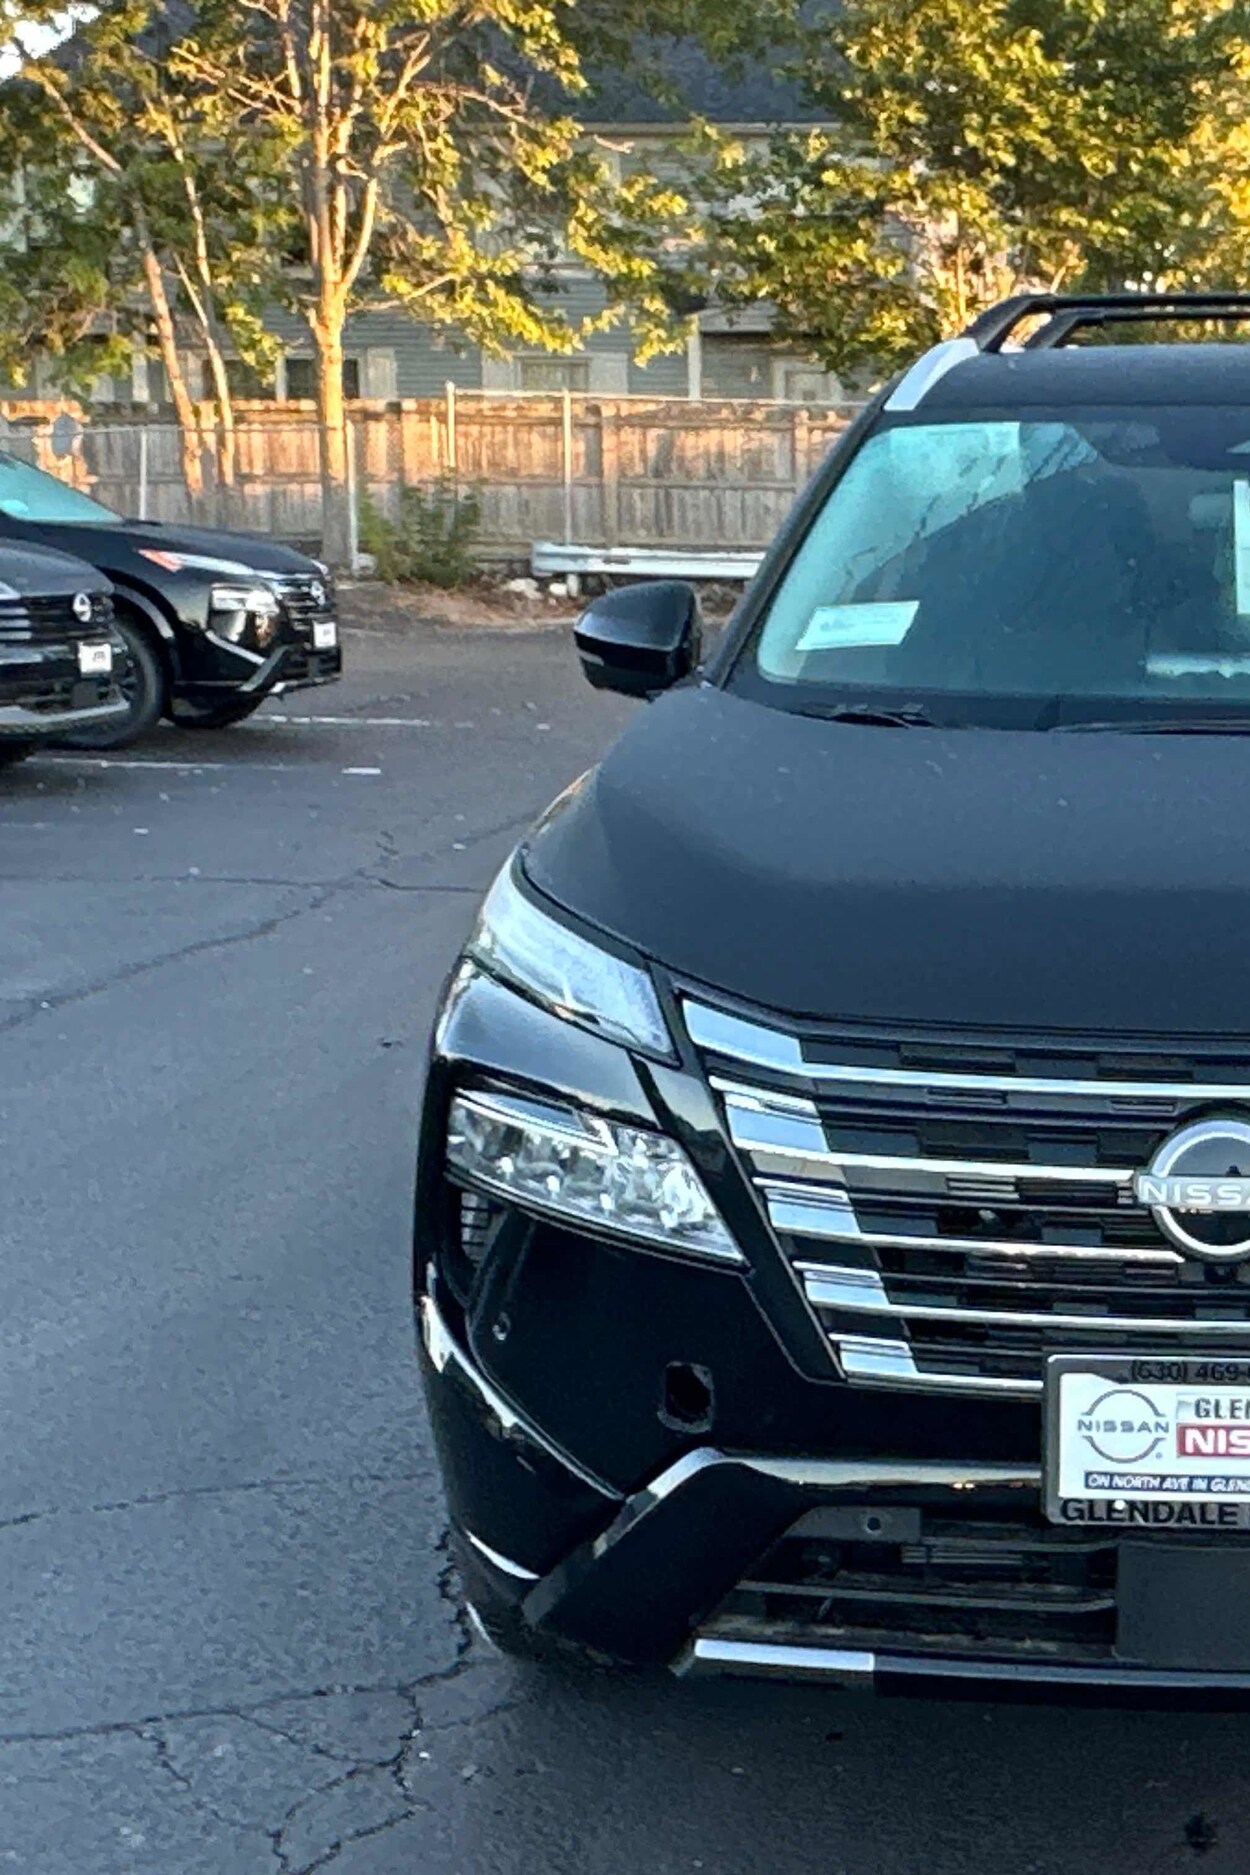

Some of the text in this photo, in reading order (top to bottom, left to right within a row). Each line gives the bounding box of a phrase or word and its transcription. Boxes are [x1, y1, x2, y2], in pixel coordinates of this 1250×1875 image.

[1131, 1360, 1188, 1382] (630)
[1077, 1419, 1169, 1434] NISSAN
[1087, 1473, 1111, 1488] ON
[1112, 1474, 1160, 1490] NORTH
[1162, 1475, 1190, 1491] AVE
[1192, 1476, 1208, 1491] IN
[1060, 1498, 1239, 1526] GLENDALE
